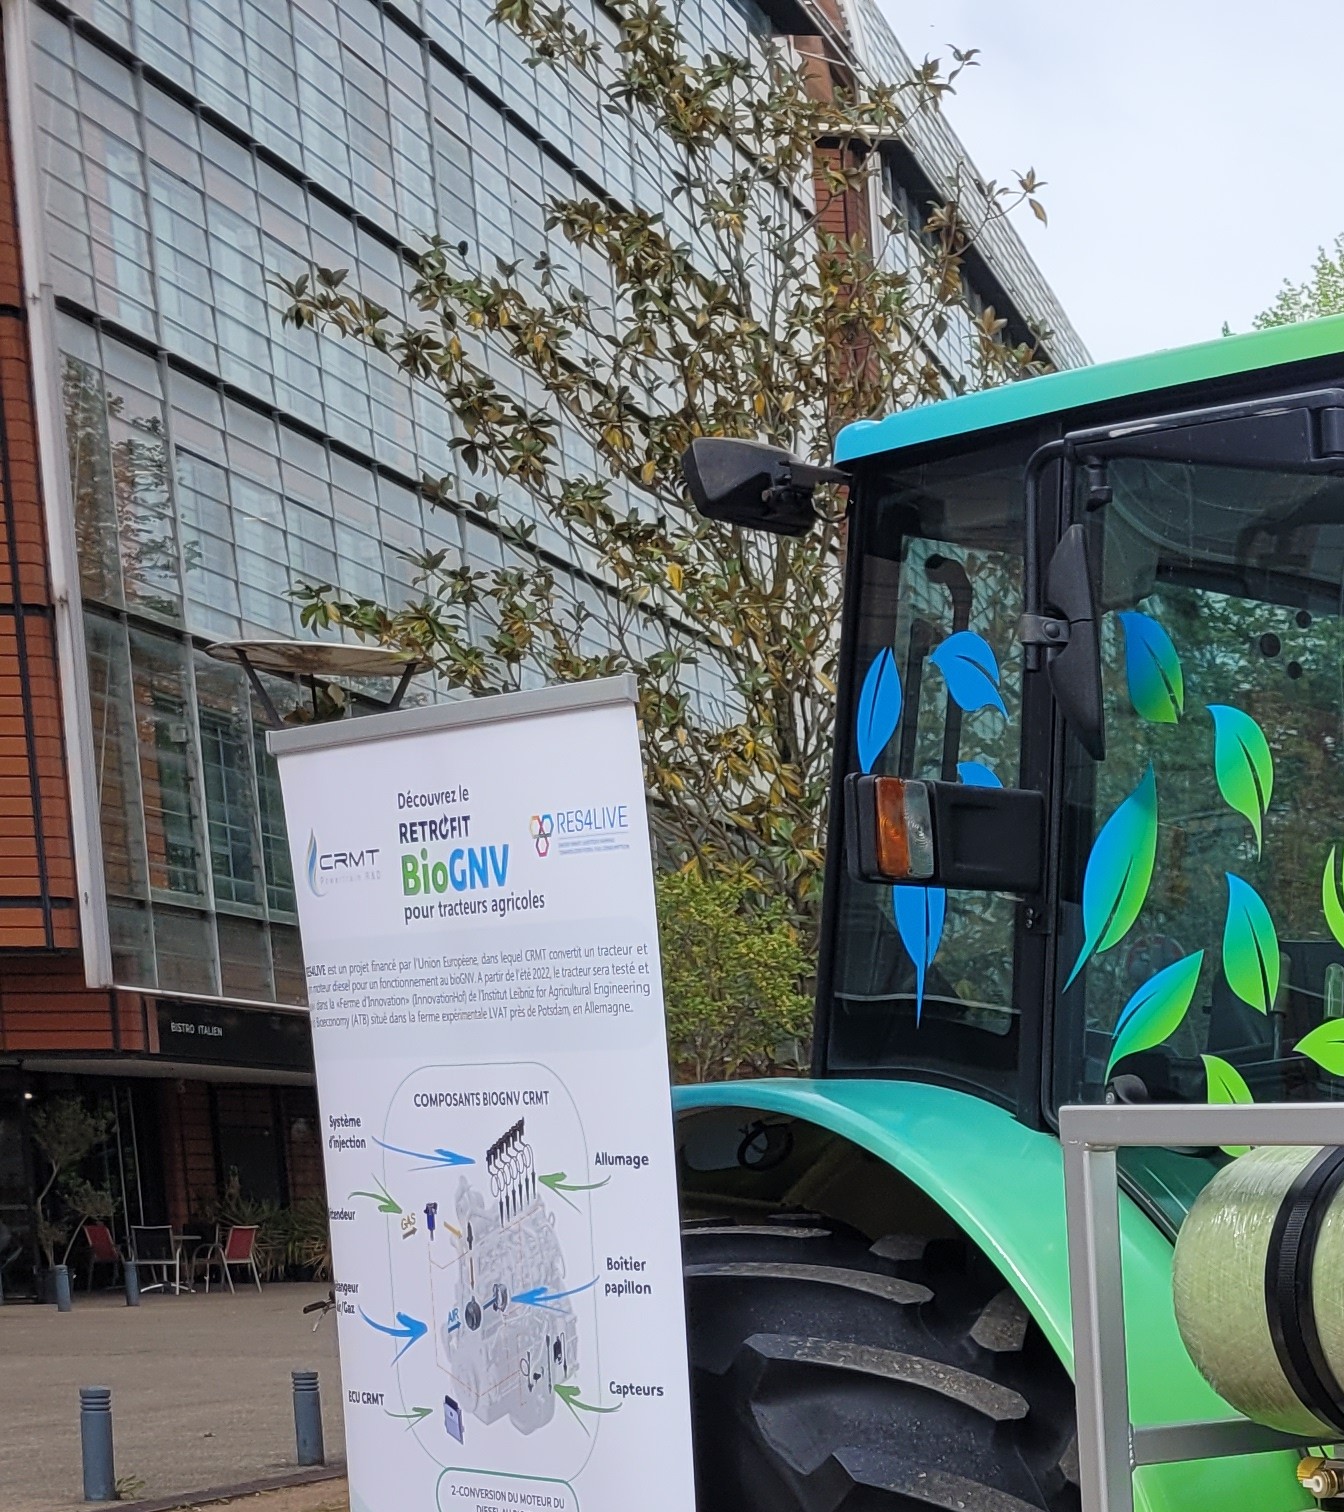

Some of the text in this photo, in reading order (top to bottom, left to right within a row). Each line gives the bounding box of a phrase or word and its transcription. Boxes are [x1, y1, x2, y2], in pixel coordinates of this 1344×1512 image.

[398, 784, 469, 809] Découvrez le
[399, 812, 471, 844] RETROFIT
[557, 806, 628, 834] RES4LIVE
[319, 849, 380, 870] CRMT
[401, 844, 509, 896] BioGNV
[404, 890, 545, 925] pour tracteurs agricoles
[598, 944, 648, 957] tracteur et
[562, 967, 591, 978] tracteur
[593, 967, 609, 976] sera
[612, 962, 635, 975] testé
[638, 963, 649, 975] et
[548, 983, 591, 1000] Agricultural
[594, 981, 650, 997] Engineering
[527, 1005, 536, 1017] de
[171, 1022, 223, 1036] BISTRO ITALIEN
[414, 1091, 550, 1107] COMPOSANTS BIOGNV CRMT
[329, 1114, 361, 1131] Système
[329, 1135, 366, 1152] d'injection
[594, 1152, 649, 1167] Allumage
[401, 1213, 416, 1230] GAS
[606, 1256, 646, 1272] Boîtier
[604, 1280, 652, 1297] papillon
[448, 1308, 459, 1324] AIR
[348, 1390, 385, 1406] ECU CRMT
[609, 1381, 664, 1398] Capteurs
[451, 1485, 565, 1509] 2-CONVERSION DU MOTEUR DU
